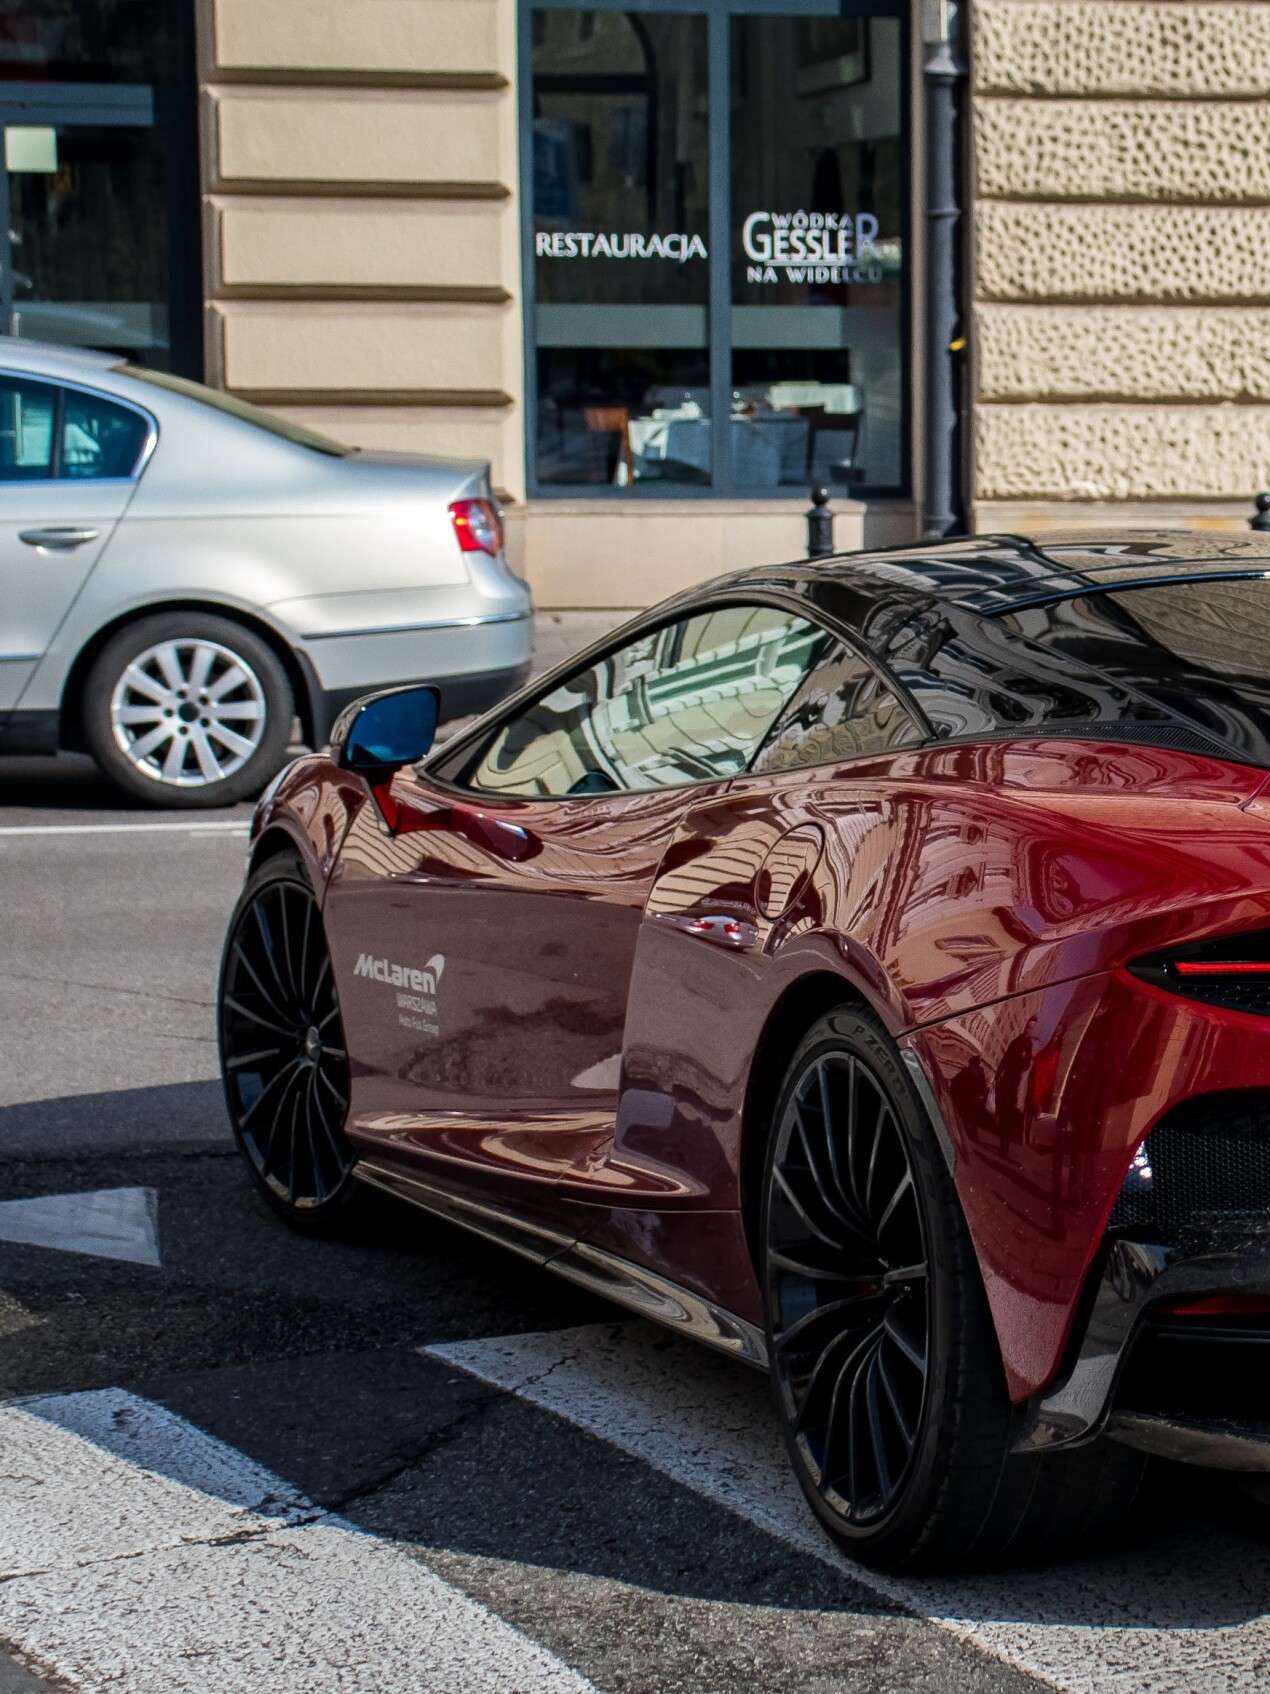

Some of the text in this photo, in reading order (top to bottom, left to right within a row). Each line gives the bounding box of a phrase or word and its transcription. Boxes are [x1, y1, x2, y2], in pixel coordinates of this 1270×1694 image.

[742, 211, 881, 262] GESSLER
[772, 209, 853, 230] WÓDKA
[535, 232, 708, 264] RESTAURACJA
[746, 266, 883, 284] NA WIDELCU
[353, 953, 436, 995] McLaren
[853, 1025, 906, 1095] P ZERO
